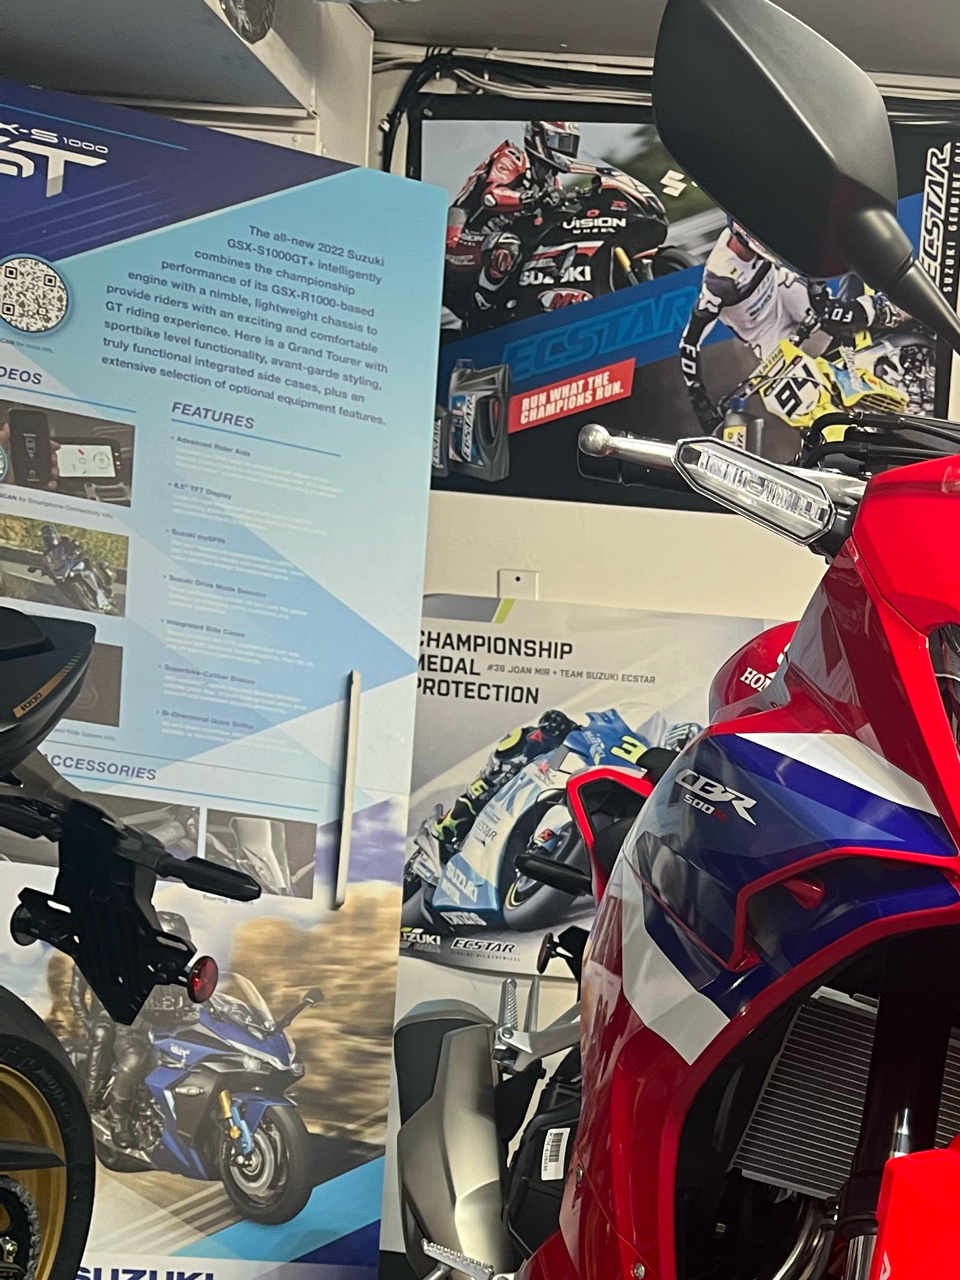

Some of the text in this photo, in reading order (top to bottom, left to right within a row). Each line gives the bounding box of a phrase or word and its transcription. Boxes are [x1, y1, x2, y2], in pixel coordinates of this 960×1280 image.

[917, 141, 952, 289] ECSTAR
[194, 250, 355, 297] combines the championship
[227, 238, 382, 286] GSX-S1000GT+ intelligently
[249, 225, 385, 267] The all-new 2022 Suzuki
[942, 241, 957, 293] SUZUKI
[128, 271, 378, 337] engine with a nimble, lightweight chassis to
[161, 260, 375, 318] performance of its GSX-R1000-based
[105, 300, 389, 374] GT riding experience. Here is a Grand Tourer with
[106, 285, 379, 355] provide riders with an exciting and comfortable
[501, 284, 699, 385] ECSTAR
[102, 337, 366, 404] truly functional integrated side cases, plus an
[104, 320, 383, 392] sportbike level functionality, avant-garde styling,
[101, 356, 387, 426] extensive selection of optional equipment features.
[171, 401, 256, 429] FEATURES
[519, 381, 625, 425] CHAMPIONS RUN.
[521, 371, 611, 411] RUN WHAT THE
[507, 665, 533, 676] JOAN
[533, 667, 551, 677] MIR
[559, 669, 584, 681] TEAM
[585, 671, 620, 682] SUZUKI
[621, 673, 657, 685] ECSTAR
[674, 768, 758, 827] CBR
[450, 937, 517, 954] ECSTAR
